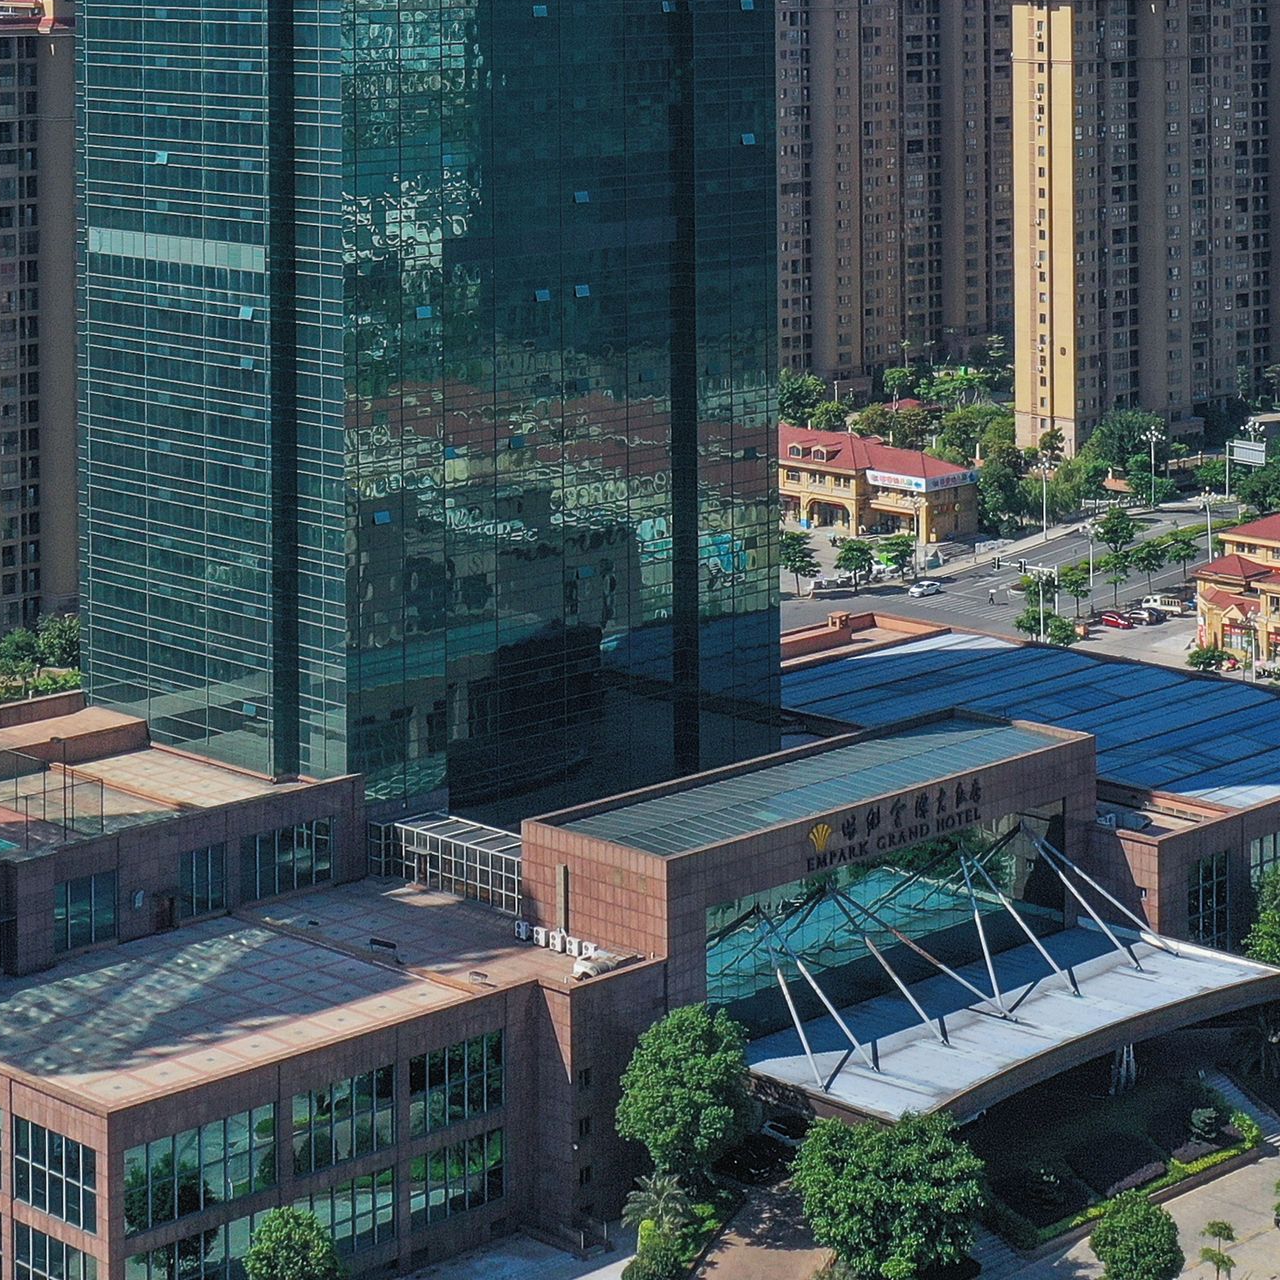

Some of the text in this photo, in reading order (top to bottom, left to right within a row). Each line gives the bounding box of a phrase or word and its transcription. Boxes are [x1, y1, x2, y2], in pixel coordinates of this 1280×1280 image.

[807, 807, 981, 872] EMPARK GRAND HOTEL
